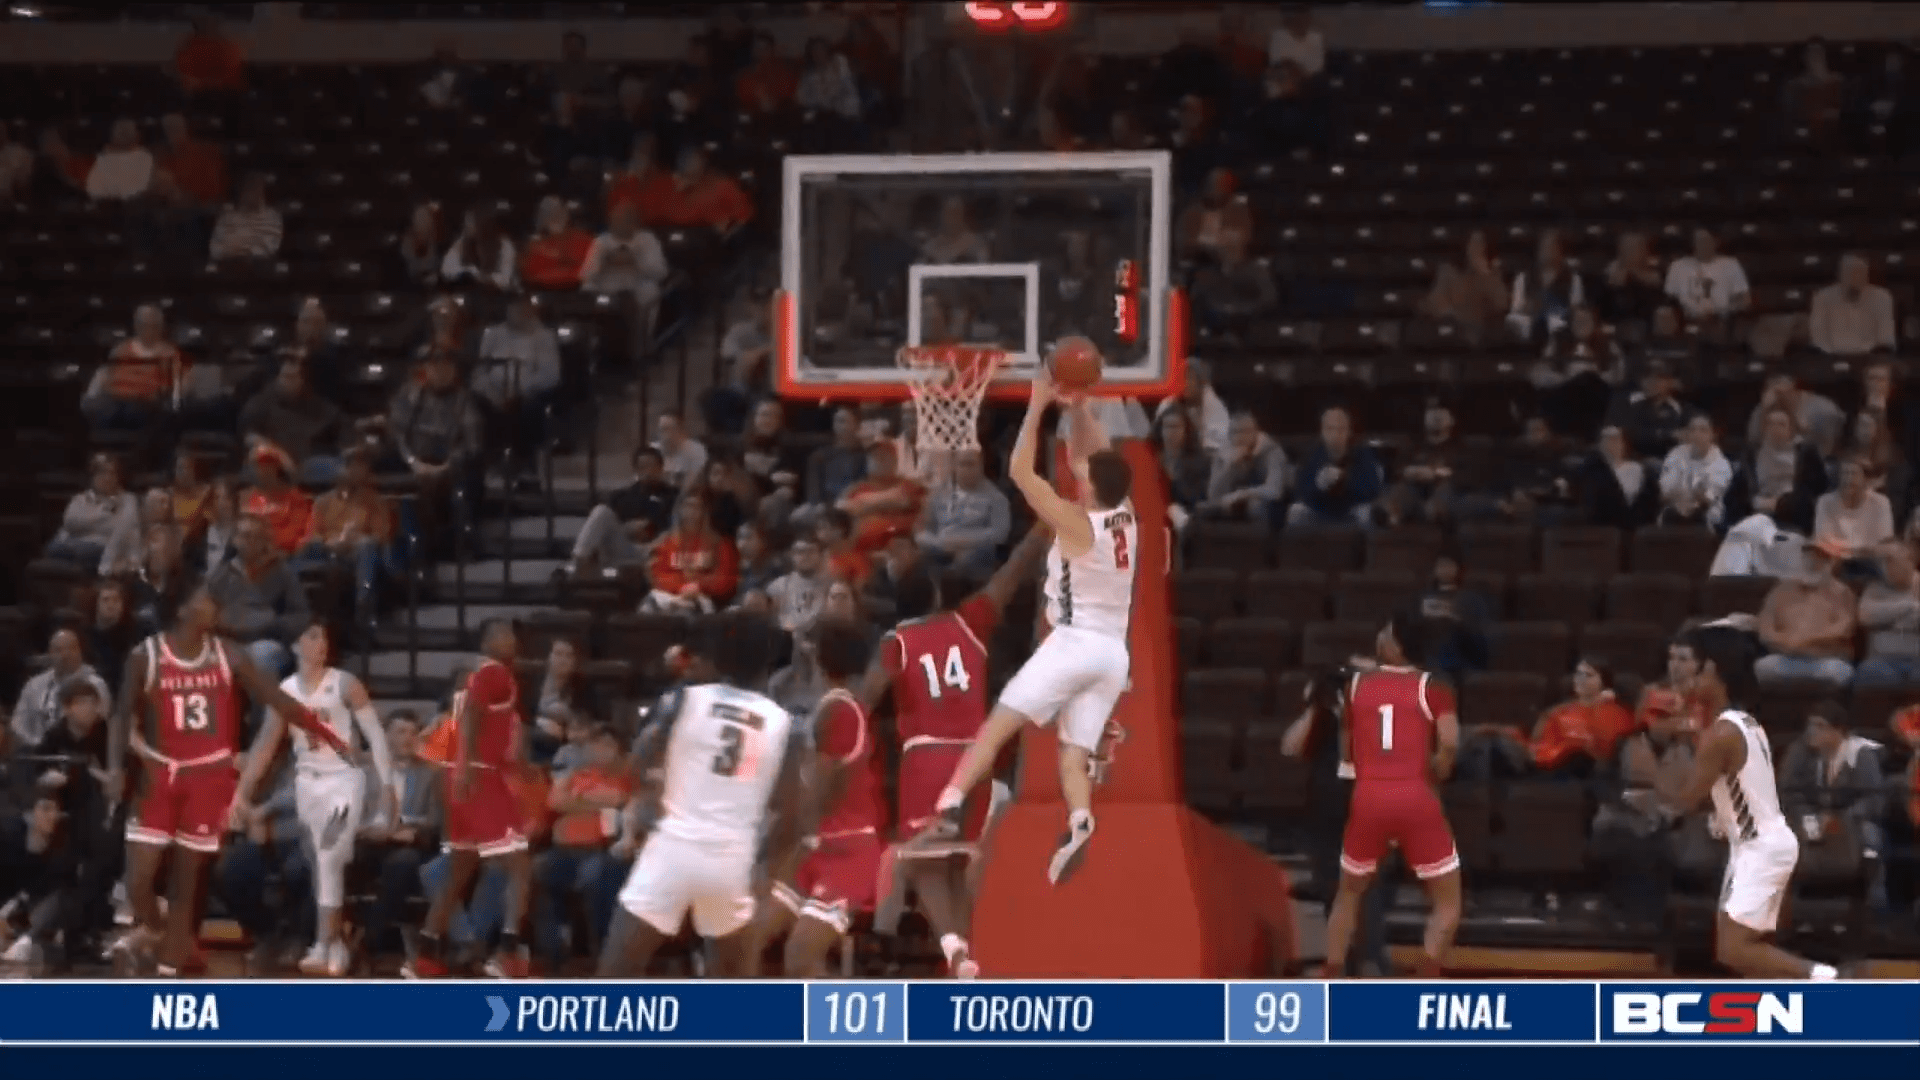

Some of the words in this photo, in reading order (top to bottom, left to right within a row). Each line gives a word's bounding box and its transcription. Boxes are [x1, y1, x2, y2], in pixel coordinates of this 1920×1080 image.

[1111, 527, 1130, 570] 2
[918, 643, 972, 699] 14
[171, 692, 209, 731] 13
[1377, 702, 1395, 751] 1
[711, 724, 747, 778] 3
